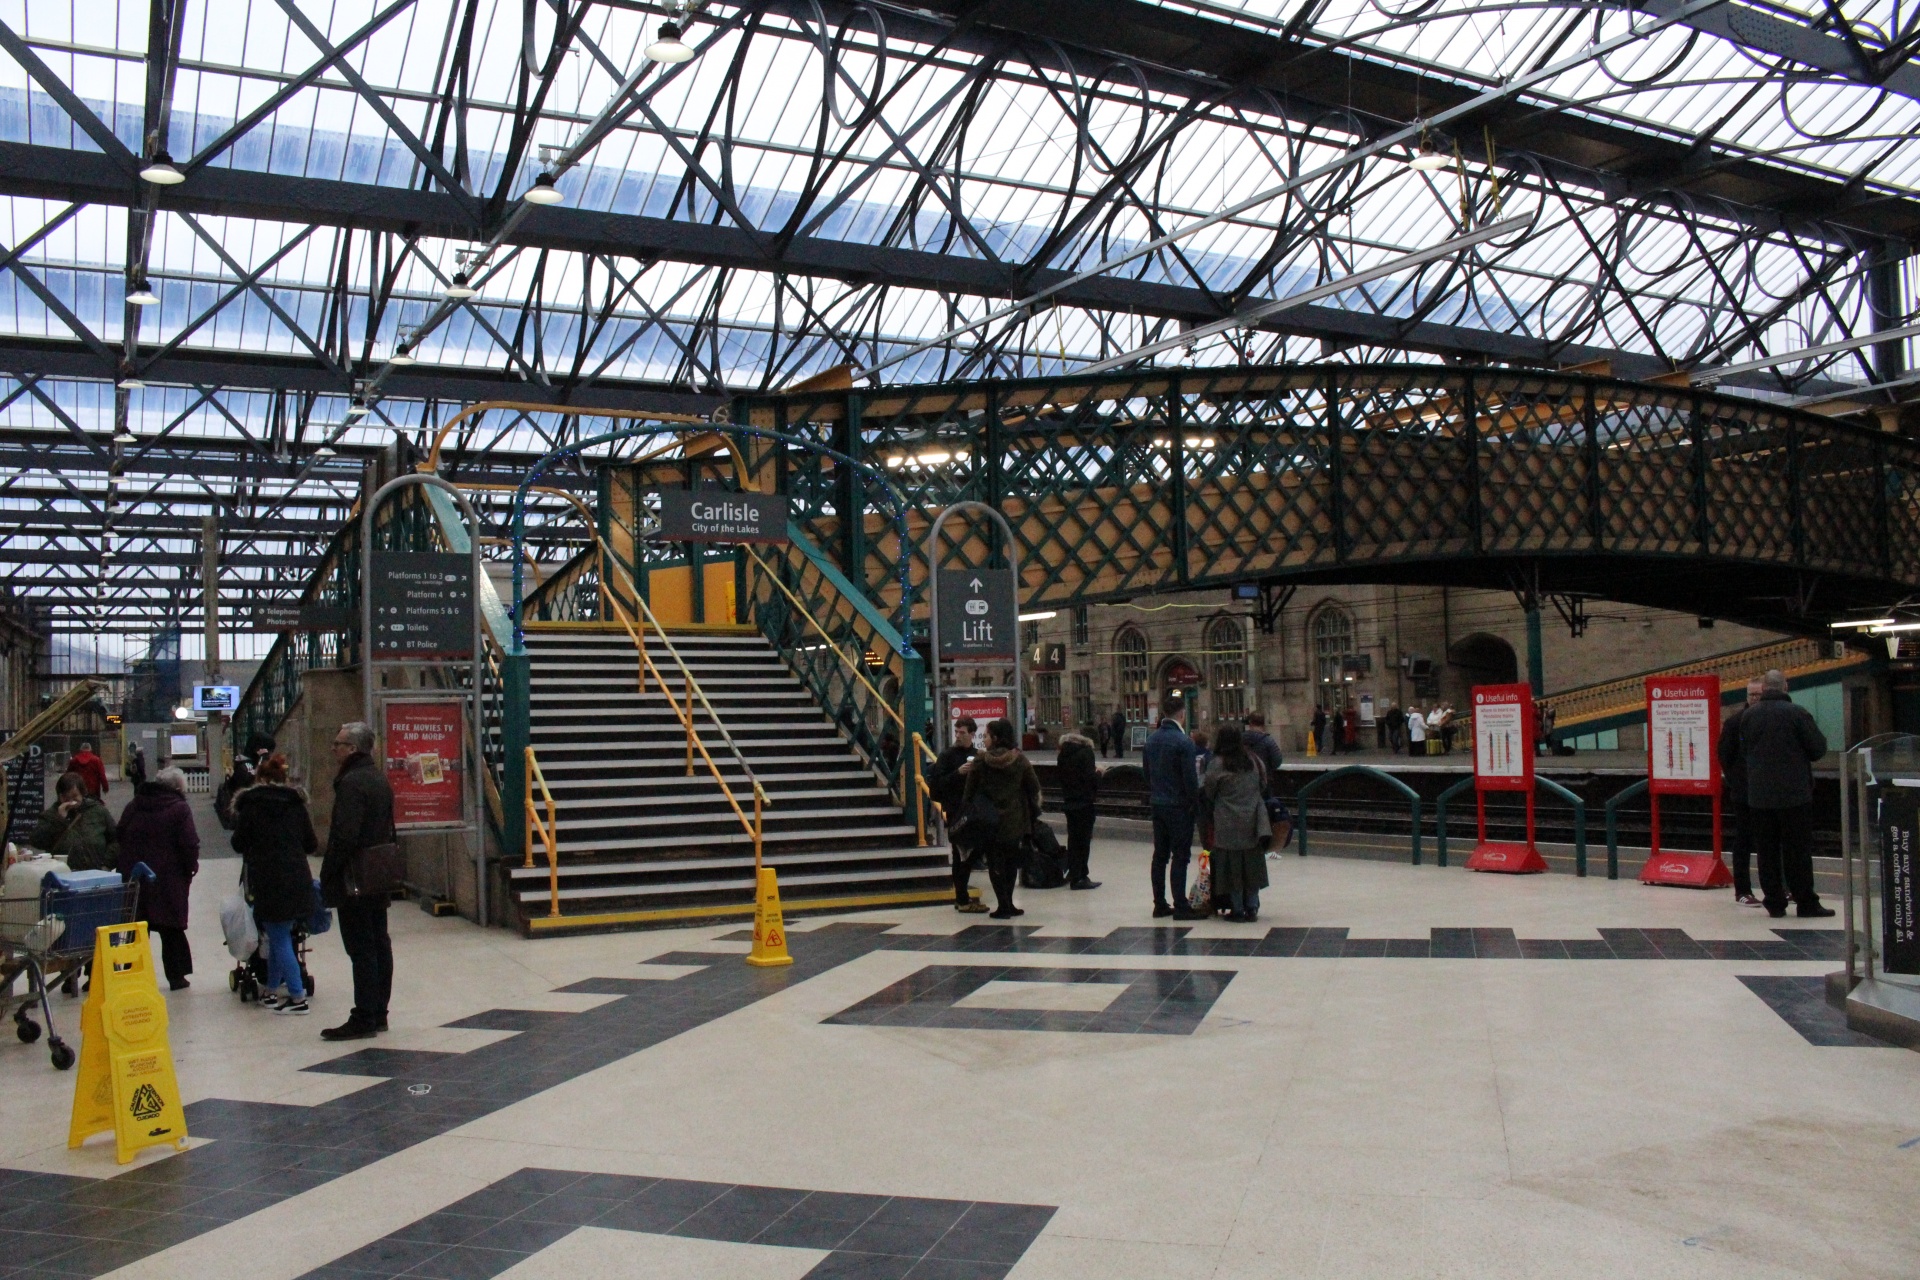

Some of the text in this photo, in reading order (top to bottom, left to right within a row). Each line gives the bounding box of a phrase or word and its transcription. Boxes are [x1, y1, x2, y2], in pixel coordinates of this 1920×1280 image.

[691, 502, 759, 522] Carlisle
[692, 523, 759, 534] City of the Lakes
[388, 571, 422, 580] Platforms
[423, 572, 427, 580] 1
[439, 572, 443, 580] 3
[407, 590, 437, 598] Platform
[267, 608, 300, 616] Telephone
[406, 606, 460, 615] Platforms 5 & 6
[407, 623, 429, 631] Toilets
[963, 619, 993, 641] Lift
[1033, 647, 1040, 664] 4
[1050, 647, 1060, 664] 4
[1836, 644, 1843, 657] 3
[1485, 693, 1518, 702] Useful info
[1664, 688, 1705, 697] Useful info
[962, 706, 1003, 716] Important info
[392, 723, 454, 732] FREE MOVIES TV
[403, 732, 419, 740] AND
[1890, 825, 1899, 842] get
[1893, 853, 1901, 884] coffee
[1901, 830, 1914, 940] Buy any sandwich &
[1894, 903, 1903, 927] only
[1896, 929, 1904, 943] £1
[124, 1006, 149, 1014] CAUTION
[121, 1011, 152, 1021] ATTENTION
[125, 1018, 150, 1026] CUIDADO
[129, 1088, 140, 1111] CAUTION
[147, 1083, 165, 1107] ATTENTION
[137, 1113, 160, 1121] CUIDADO
